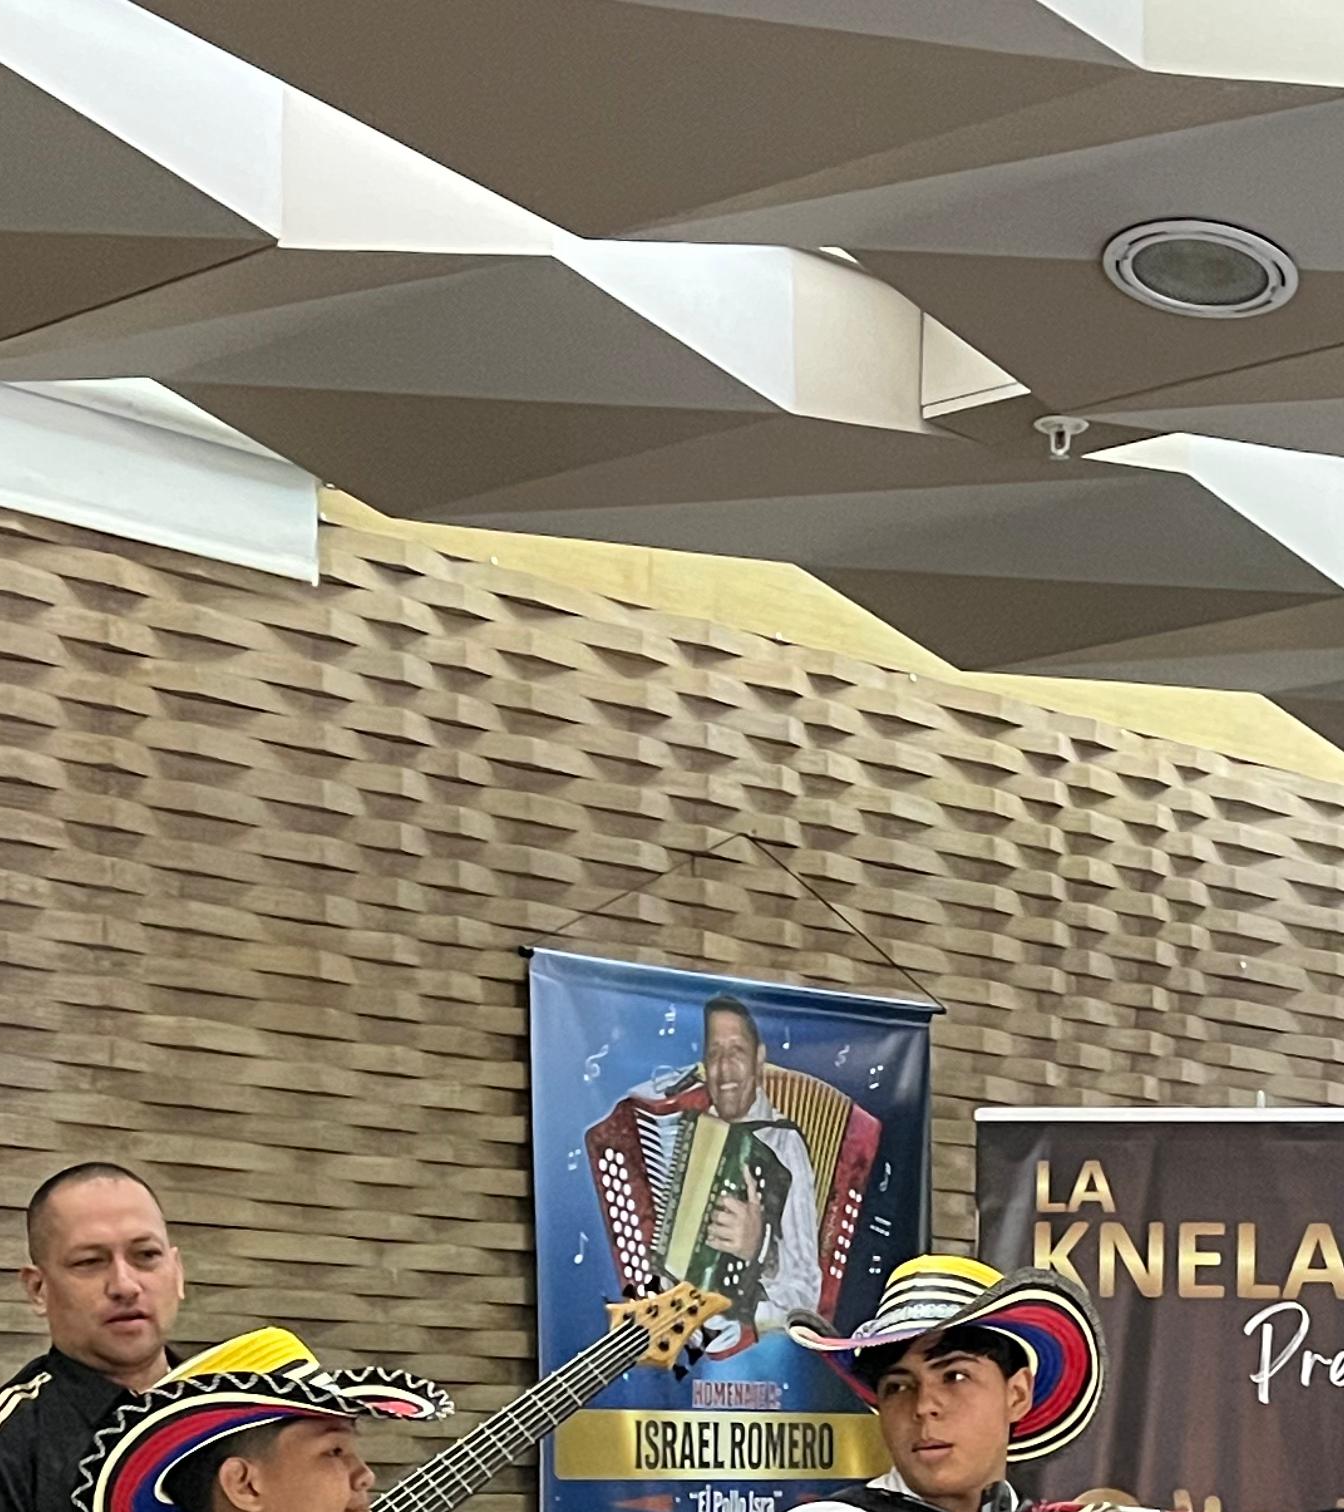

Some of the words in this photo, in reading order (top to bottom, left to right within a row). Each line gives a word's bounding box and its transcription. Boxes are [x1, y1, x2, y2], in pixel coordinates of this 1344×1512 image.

[1035, 1159, 1116, 1213] LA
[634, 1420, 725, 1470] ISRAEL
[730, 1422, 834, 1470] ROMERO
